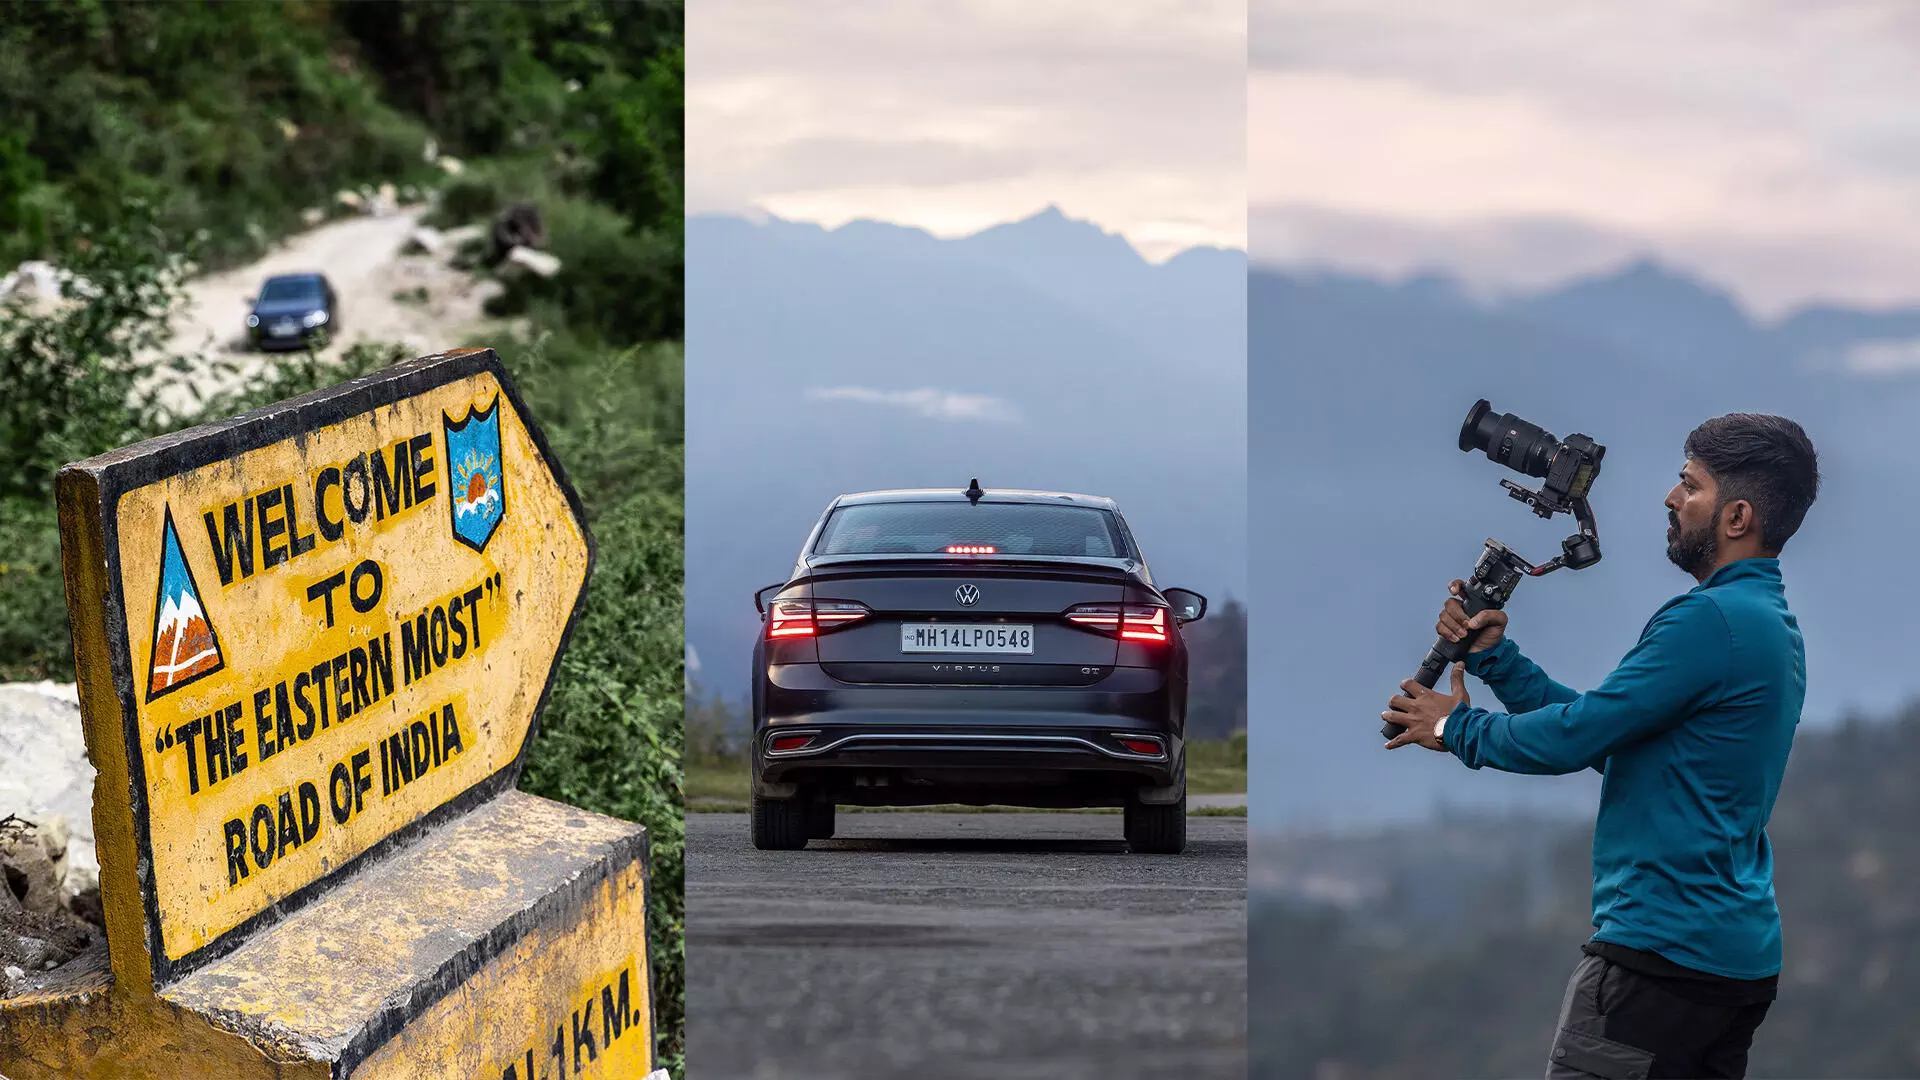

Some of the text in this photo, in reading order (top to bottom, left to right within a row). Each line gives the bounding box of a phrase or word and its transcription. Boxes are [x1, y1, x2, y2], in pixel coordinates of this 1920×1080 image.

[204, 432, 437, 587] WELCOME
[306, 559, 383, 628] TO
[916, 628, 1030, 648] MH14LP0548
[932, 665, 1000, 673] VIRTUS
[1081, 667, 1100, 675] GT
[253, 632, 396, 762] EASTERN
[224, 702, 464, 887] ROAD OF INDIA
